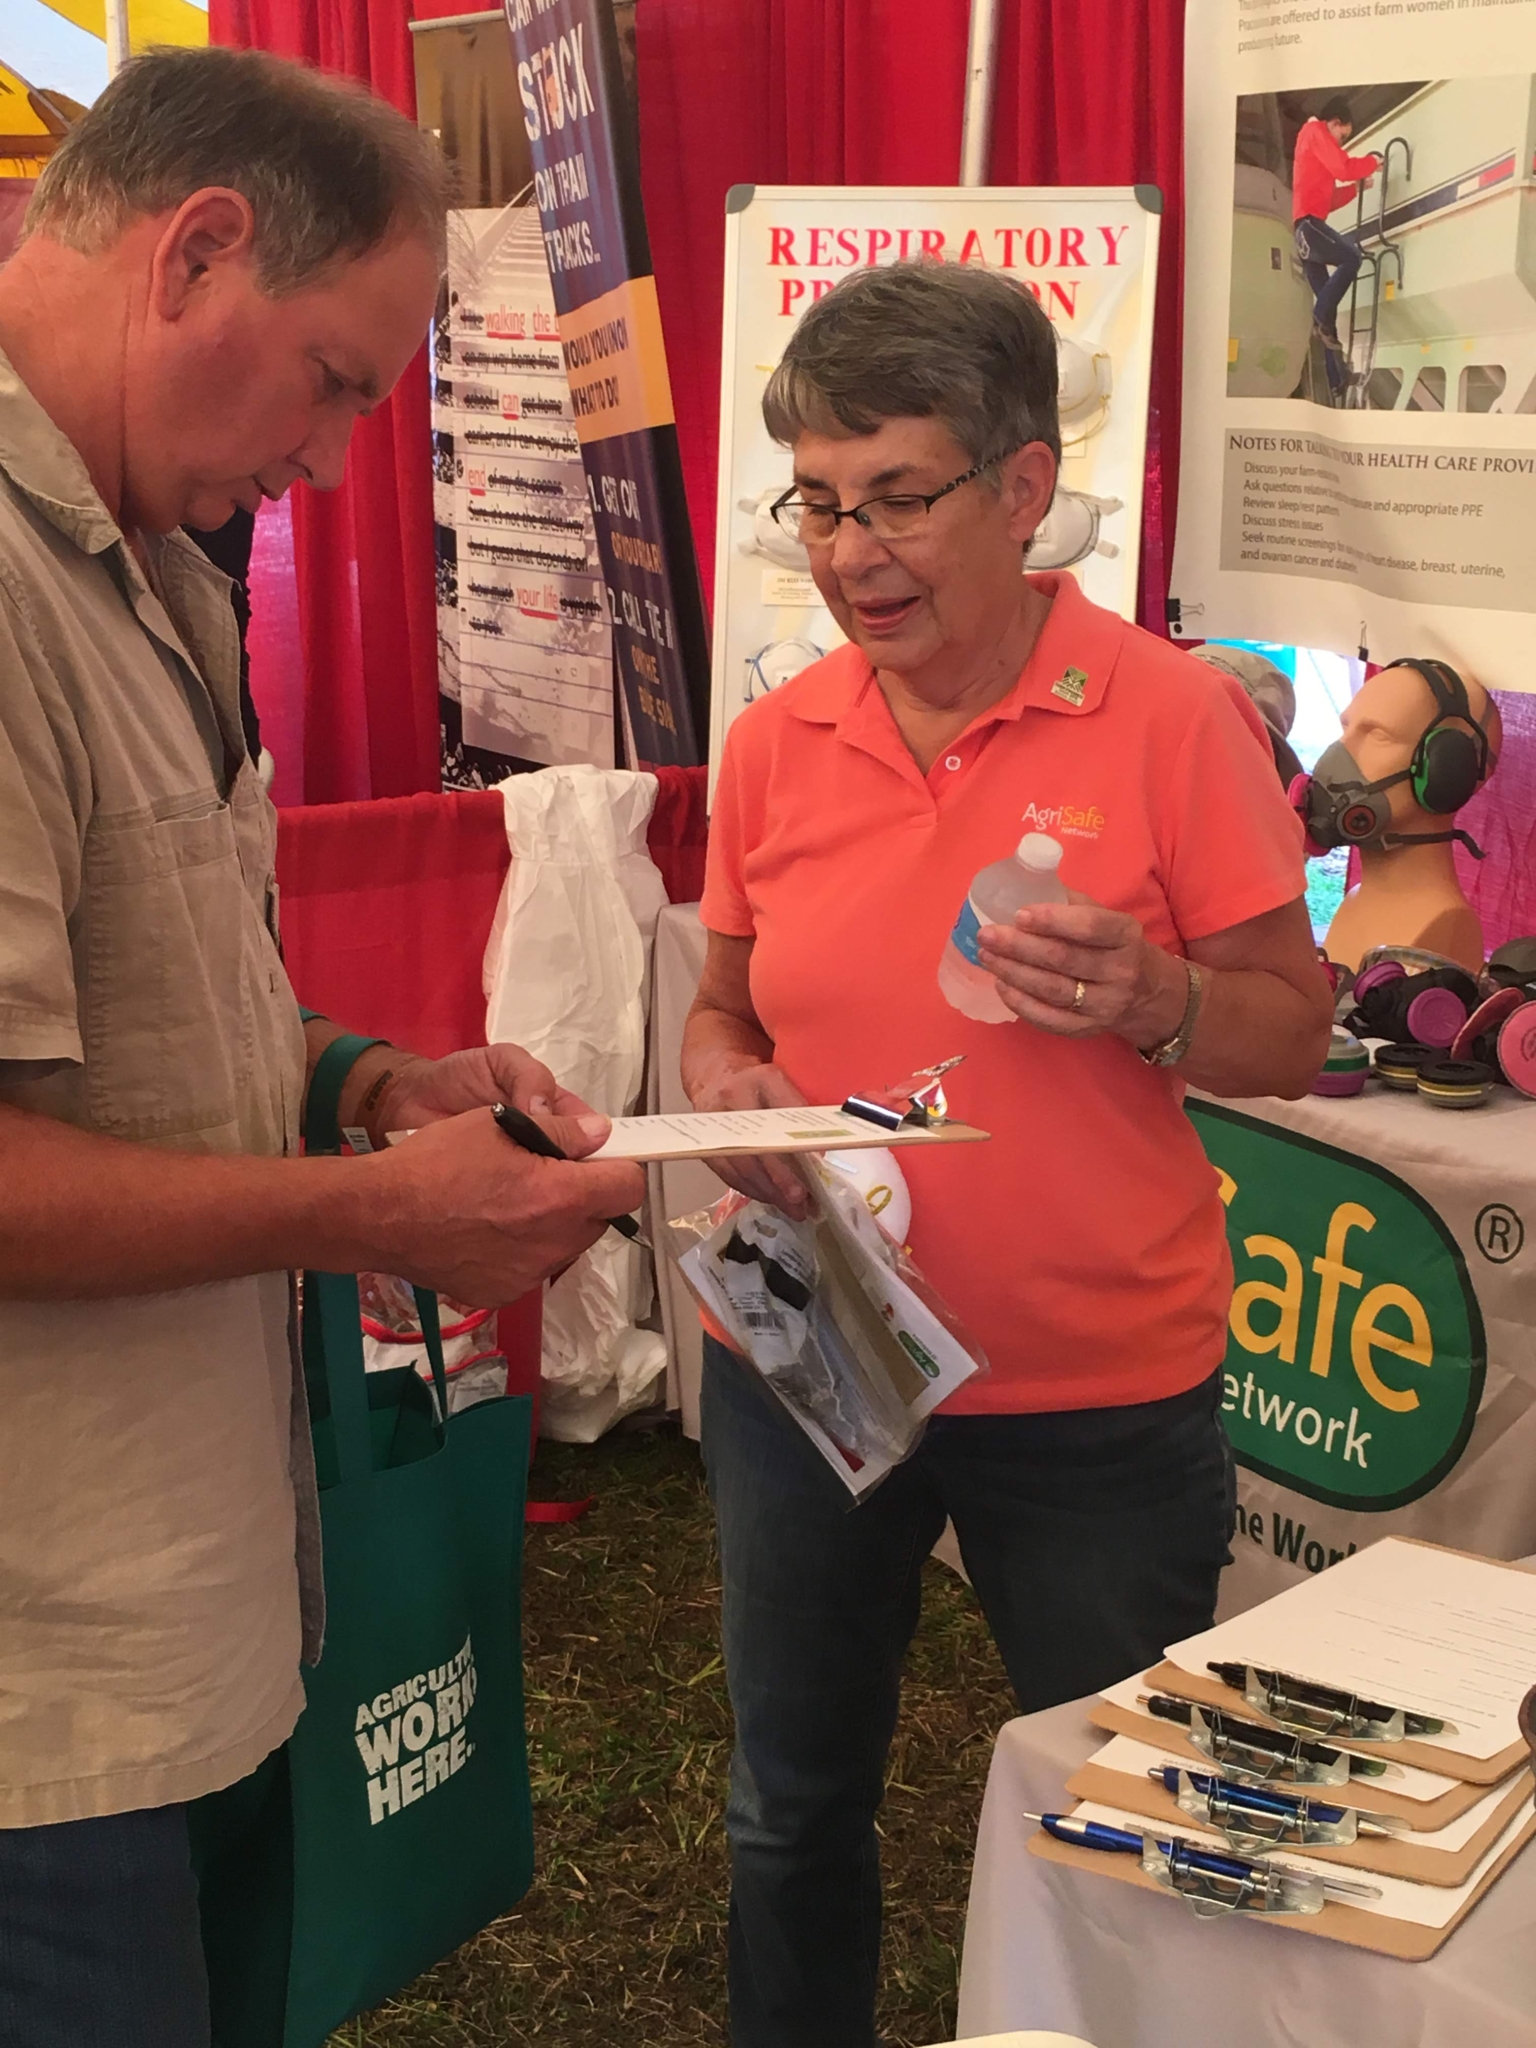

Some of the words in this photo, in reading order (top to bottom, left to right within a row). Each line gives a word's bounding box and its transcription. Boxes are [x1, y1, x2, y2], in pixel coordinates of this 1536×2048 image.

[1282, 8, 1320, 24] offered
[1323, 8, 1336, 20] to
[1339, 4, 1371, 19] assist
[1374, 2, 1403, 16] farm
[1406, 0, 1454, 13] women
[767, 226, 1129, 268] RESPIRATORY
[485, 304, 526, 336] walking
[533, 304, 551, 333] the
[502, 393, 519, 412] can
[1229, 435, 1276, 451] NOTES
[1280, 438, 1303, 453] FOR
[1367, 453, 1429, 469] HEALTH
[1434, 455, 1478, 471] CARE
[1482, 457, 1536, 474] PROVI
[1243, 461, 1278, 475] Discuss
[1279, 465, 1298, 477] your
[468, 463, 486, 487] end
[1243, 480, 1261, 491] Ask
[1262, 481, 1302, 494] questions
[1373, 498, 1390, 512] and
[1392, 501, 1459, 517] appropriate
[1461, 503, 1483, 517] PPE
[1243, 496, 1275, 509] Review
[1243, 513, 1276, 527] Discuss
[1278, 517, 1300, 530] stress
[1240, 548, 1260, 560] and
[1261, 552, 1293, 564] ovarian
[1293, 555, 1319, 566] cancer
[1242, 531, 1264, 543] Seek
[1266, 533, 1296, 546] routine
[1420, 559, 1457, 576] breast,
[1461, 563, 1506, 579] uterine,
[516, 587, 541, 612] your
[543, 584, 559, 611] life
[1021, 802, 1105, 831] AgriSafe
[1213, 1166, 1434, 1413] afe
[1220, 1371, 1373, 1469] etwork
[1273, 1512, 1357, 1574] Wor
[366, 1725, 476, 1826] HERE.
